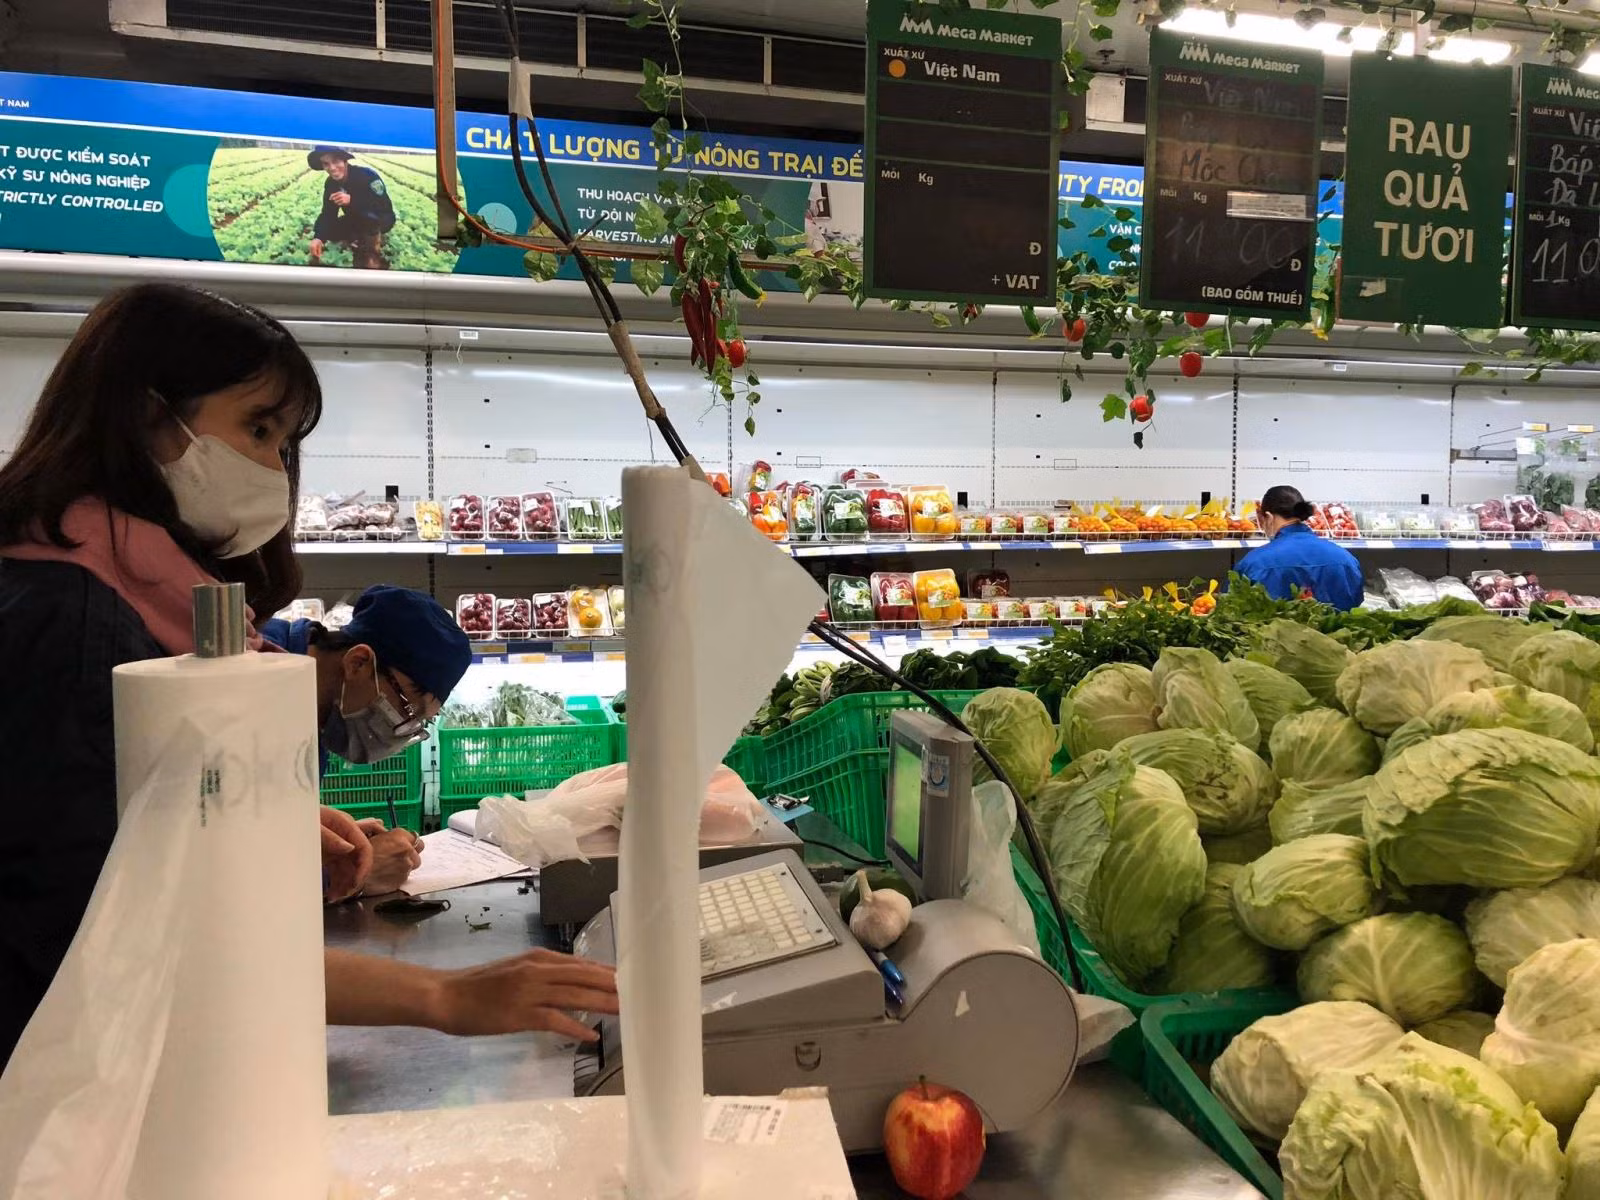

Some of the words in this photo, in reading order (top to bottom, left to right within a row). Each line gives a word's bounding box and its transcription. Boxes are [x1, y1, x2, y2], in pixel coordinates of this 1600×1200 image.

[924, 61, 958, 81] Việt
[963, 64, 1000, 83] Nam
[7, 99, 30, 109] NAM
[1388, 117, 1471, 160] RAU
[16, 146, 63, 163] ĐƯỢC
[67, 146, 104, 164] KIỂM
[108, 152, 151, 168] SOÁT
[550, 133, 640, 162] LƯỢNG
[694, 142, 760, 169] NÔNG
[768, 151, 823, 178] TRẠI
[22, 169, 46, 182] SƯ
[50, 169, 91, 185] NÔNG
[96, 174, 150, 192] NGHIỆP
[918, 172, 934, 186] Kg
[1384, 163, 1469, 212] QUẢ
[577, 187, 603, 200] THU
[1194, 192, 1207, 204] Kg
[61, 194, 164, 213] CONTROLLED
[577, 207, 596, 220] TỪ
[1558, 216, 1571, 227] Kg
[1374, 221, 1474, 263] TƯƠI
[1006, 274, 1040, 290] VAT
[1202, 286, 1233, 299] (BAO
[1267, 289, 1303, 306] THUẾ)
